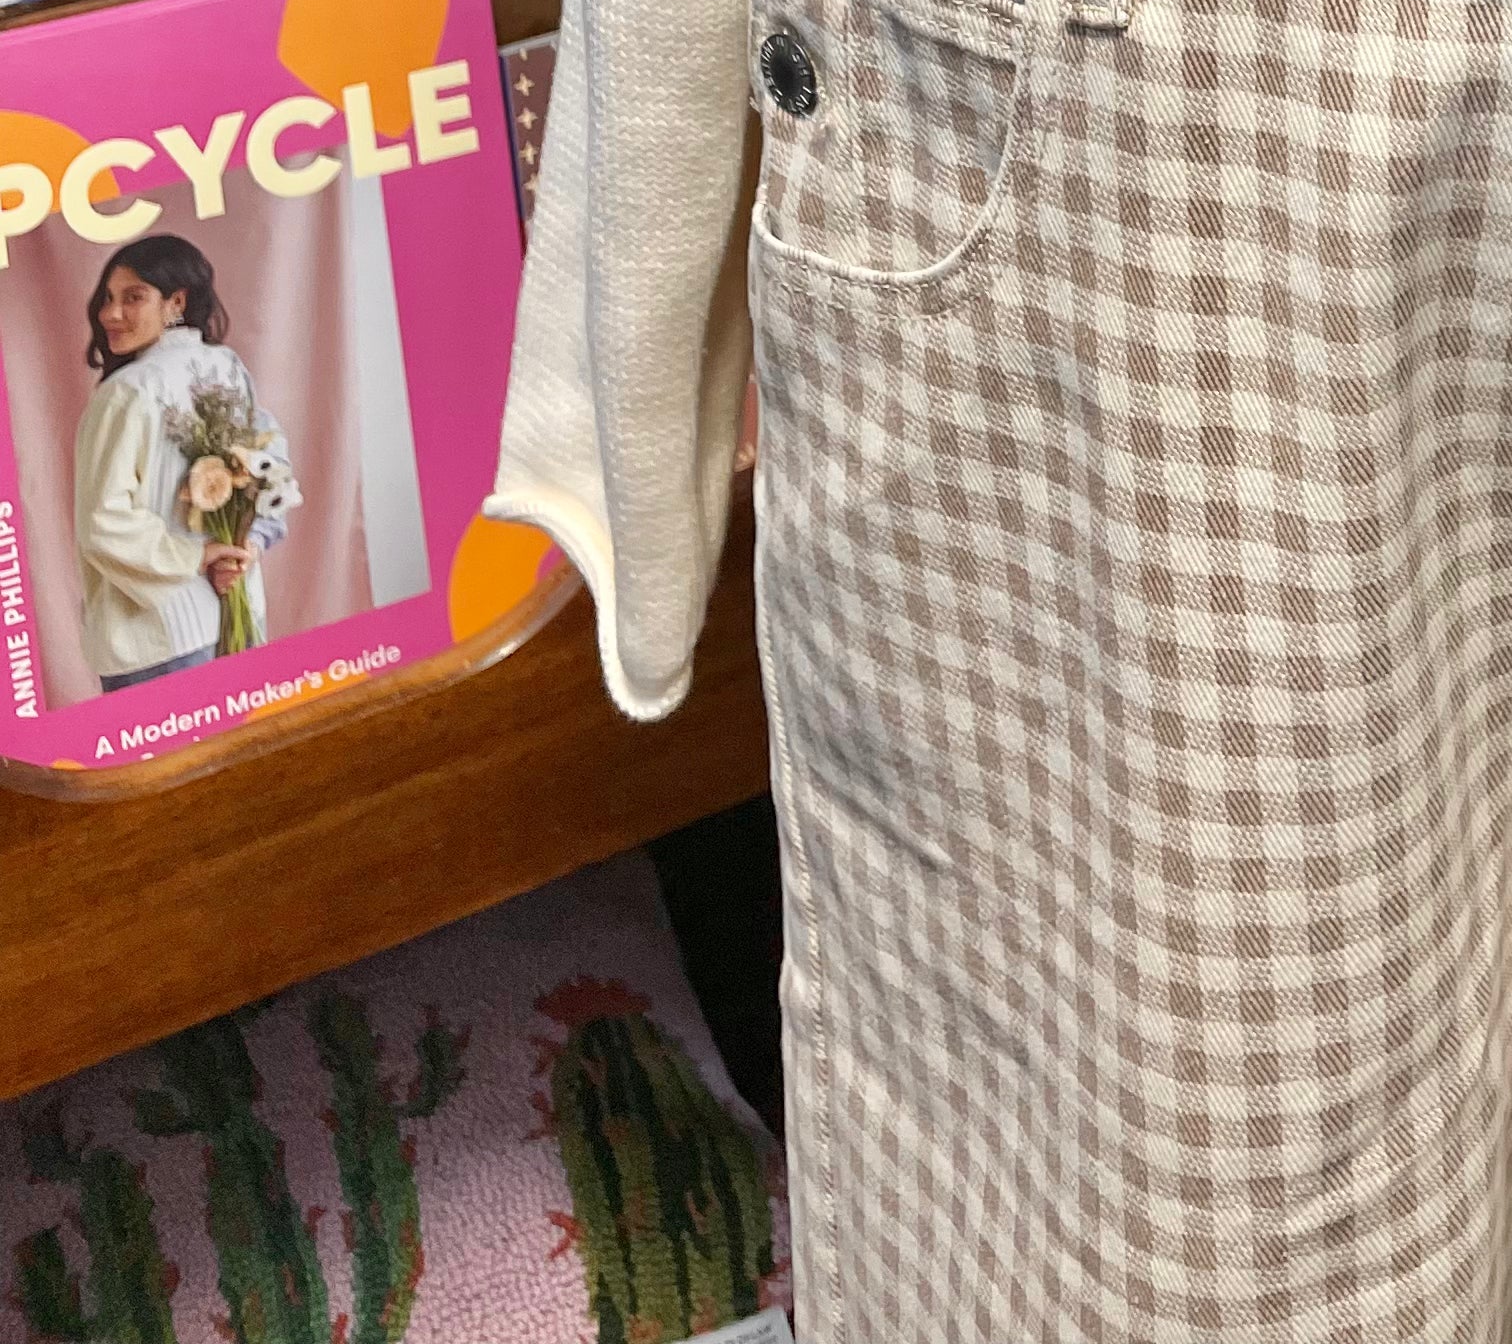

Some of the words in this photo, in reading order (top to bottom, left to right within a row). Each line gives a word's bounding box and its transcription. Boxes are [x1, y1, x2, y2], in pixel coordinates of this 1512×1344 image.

[0, 59, 480, 269] PCYCLE
[0, 501, 26, 626] PHILLIPS
[6, 630, 39, 718] ANNIE
[95, 736, 115, 759] A
[119, 703, 221, 751] Modern
[226, 669, 325, 718] Maker's
[328, 643, 402, 682] Guide
